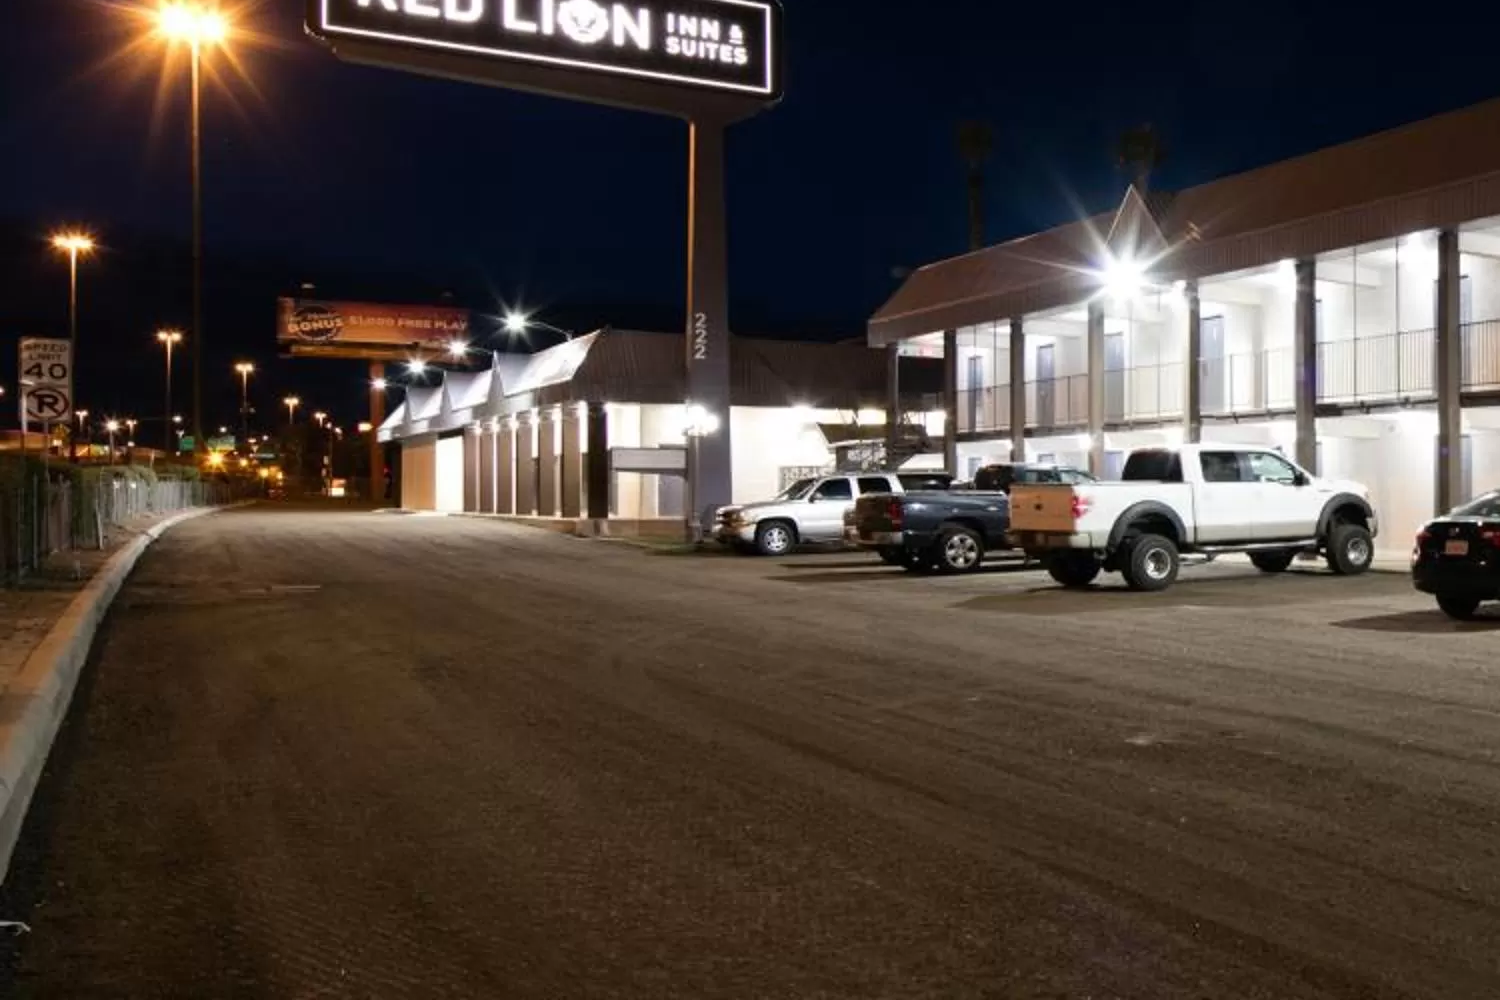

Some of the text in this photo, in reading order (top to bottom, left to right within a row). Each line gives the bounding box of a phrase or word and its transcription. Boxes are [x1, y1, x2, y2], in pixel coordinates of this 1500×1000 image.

[666, 12, 745, 44] INN &
[665, 37, 749, 66] SUITES
[288, 317, 344, 333] BONUS
[397, 317, 431, 329] FREE
[434, 319, 467, 331] PLAY
[23, 344, 67, 352] SPEED
[24, 362, 67, 379] 40
